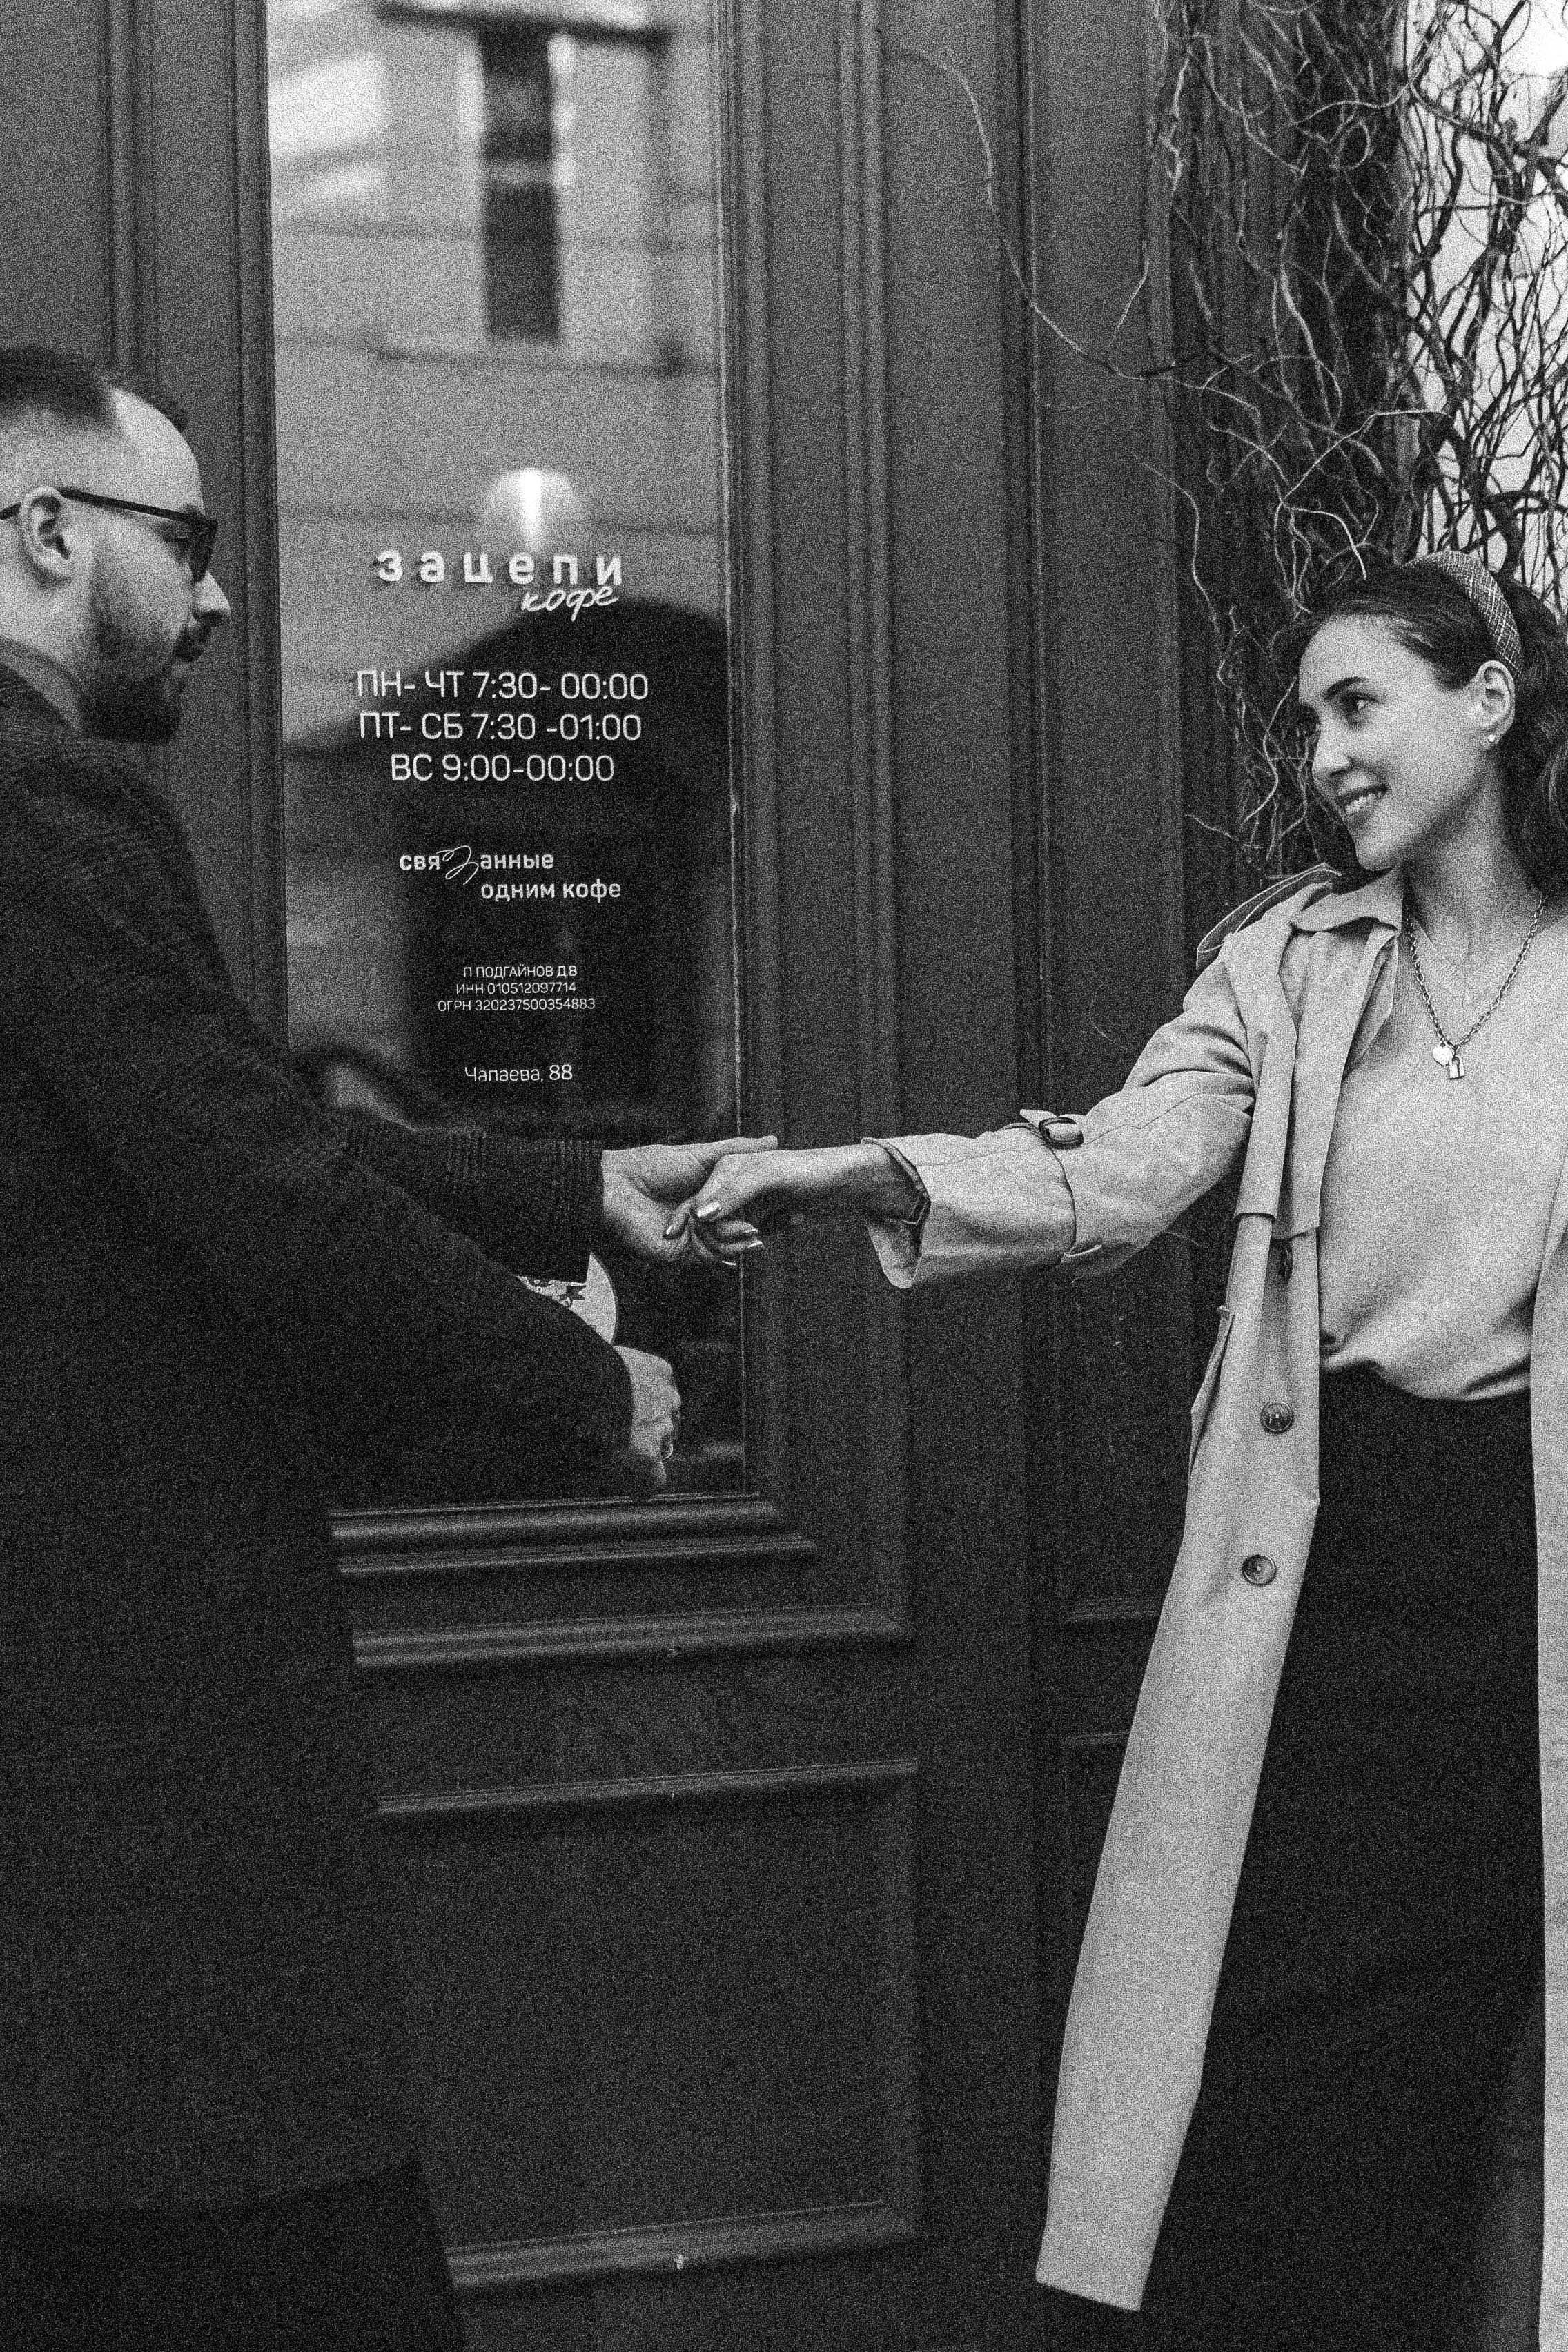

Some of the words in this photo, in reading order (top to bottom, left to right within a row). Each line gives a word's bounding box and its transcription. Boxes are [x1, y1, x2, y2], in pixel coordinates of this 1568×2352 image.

[376, 550, 622, 586] зацепи
[521, 585, 619, 621] кофе
[357, 669, 415, 698] ПН-
[425, 671, 464, 698] ЧТ
[561, 672, 649, 700] 00:00
[360, 711, 411, 740] ПТ-
[422, 712, 463, 741] СБ
[471, 713, 536, 741] 7:30
[547, 714, 642, 741] -01:00
[391, 754, 433, 782] ВС
[442, 754, 614, 781] 9:00-00:00
[481, 881, 555, 903] одним
[562, 878, 621, 903] кофе
[476, 964, 553, 979] ПОДГАЙНОВ
[456, 983, 484, 994] ИНН
[487, 981, 576, 994] 010512097714
[475, 998, 595, 1011] 320237500354883
[464, 1066, 544, 1084] Чапаева,
[549, 1064, 573, 1081] 88
